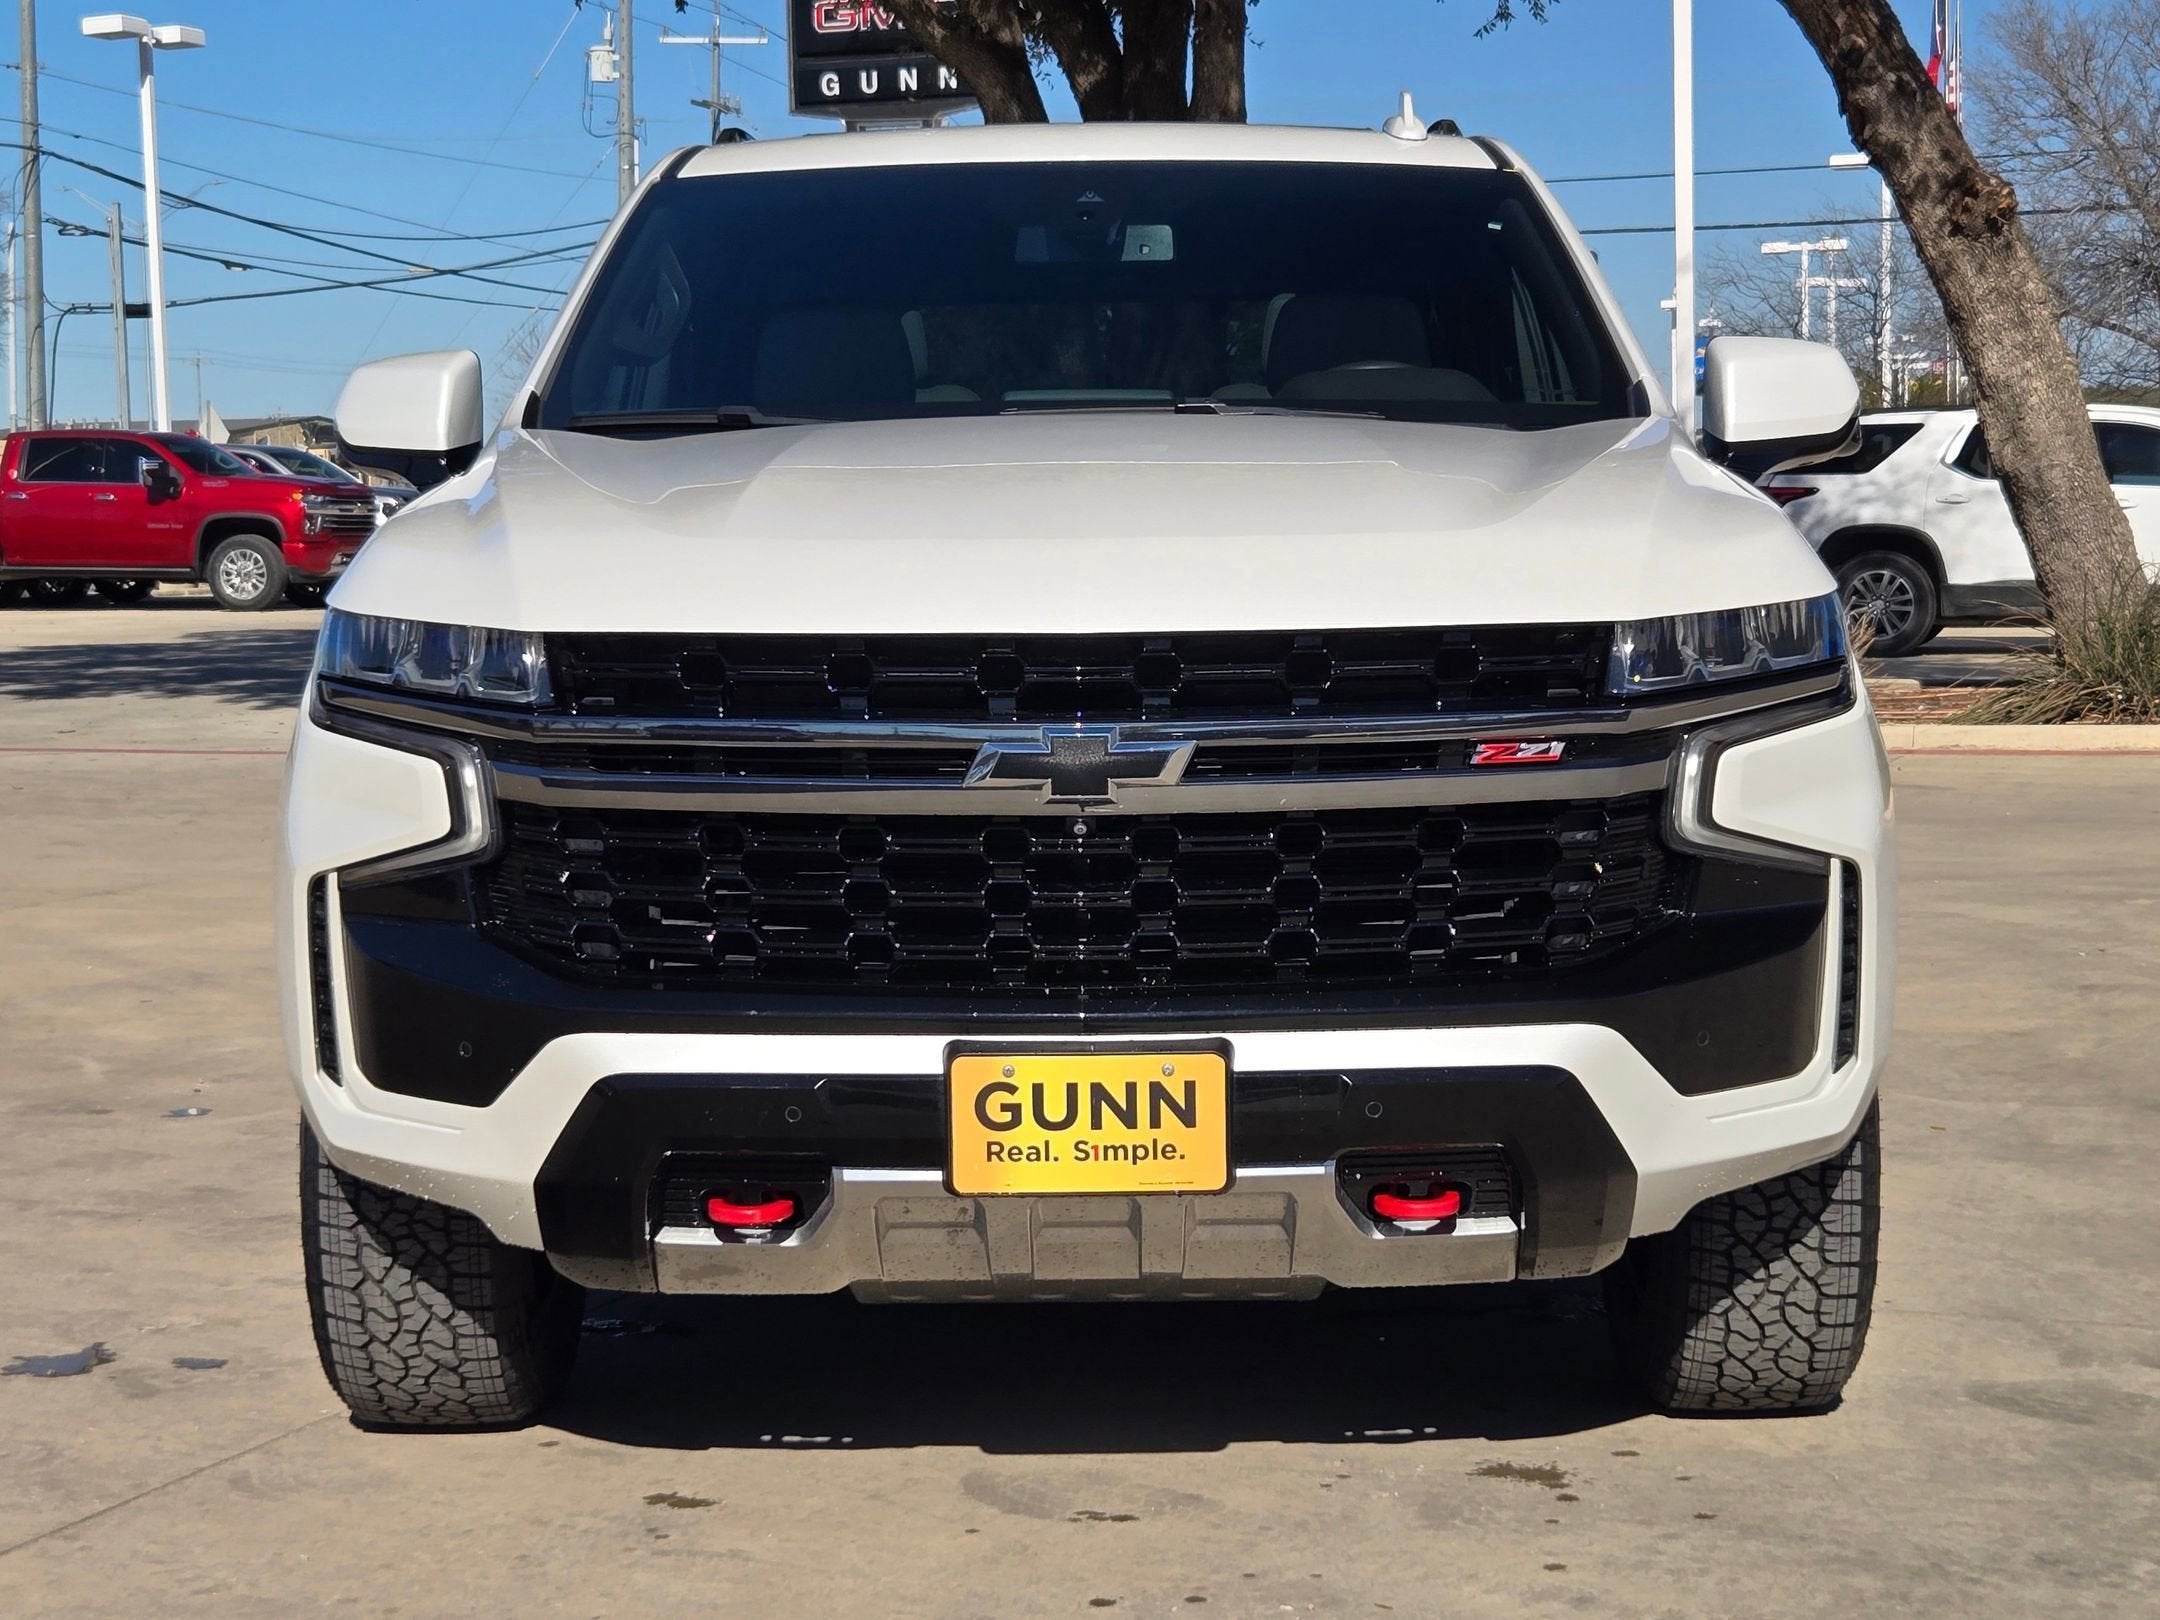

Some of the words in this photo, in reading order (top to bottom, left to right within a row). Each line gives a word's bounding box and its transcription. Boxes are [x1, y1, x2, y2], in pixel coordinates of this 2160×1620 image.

[820, 65, 958, 97] GUNN
[974, 1080, 1197, 1131] GUNN
[986, 1140, 1059, 1163] Real.
